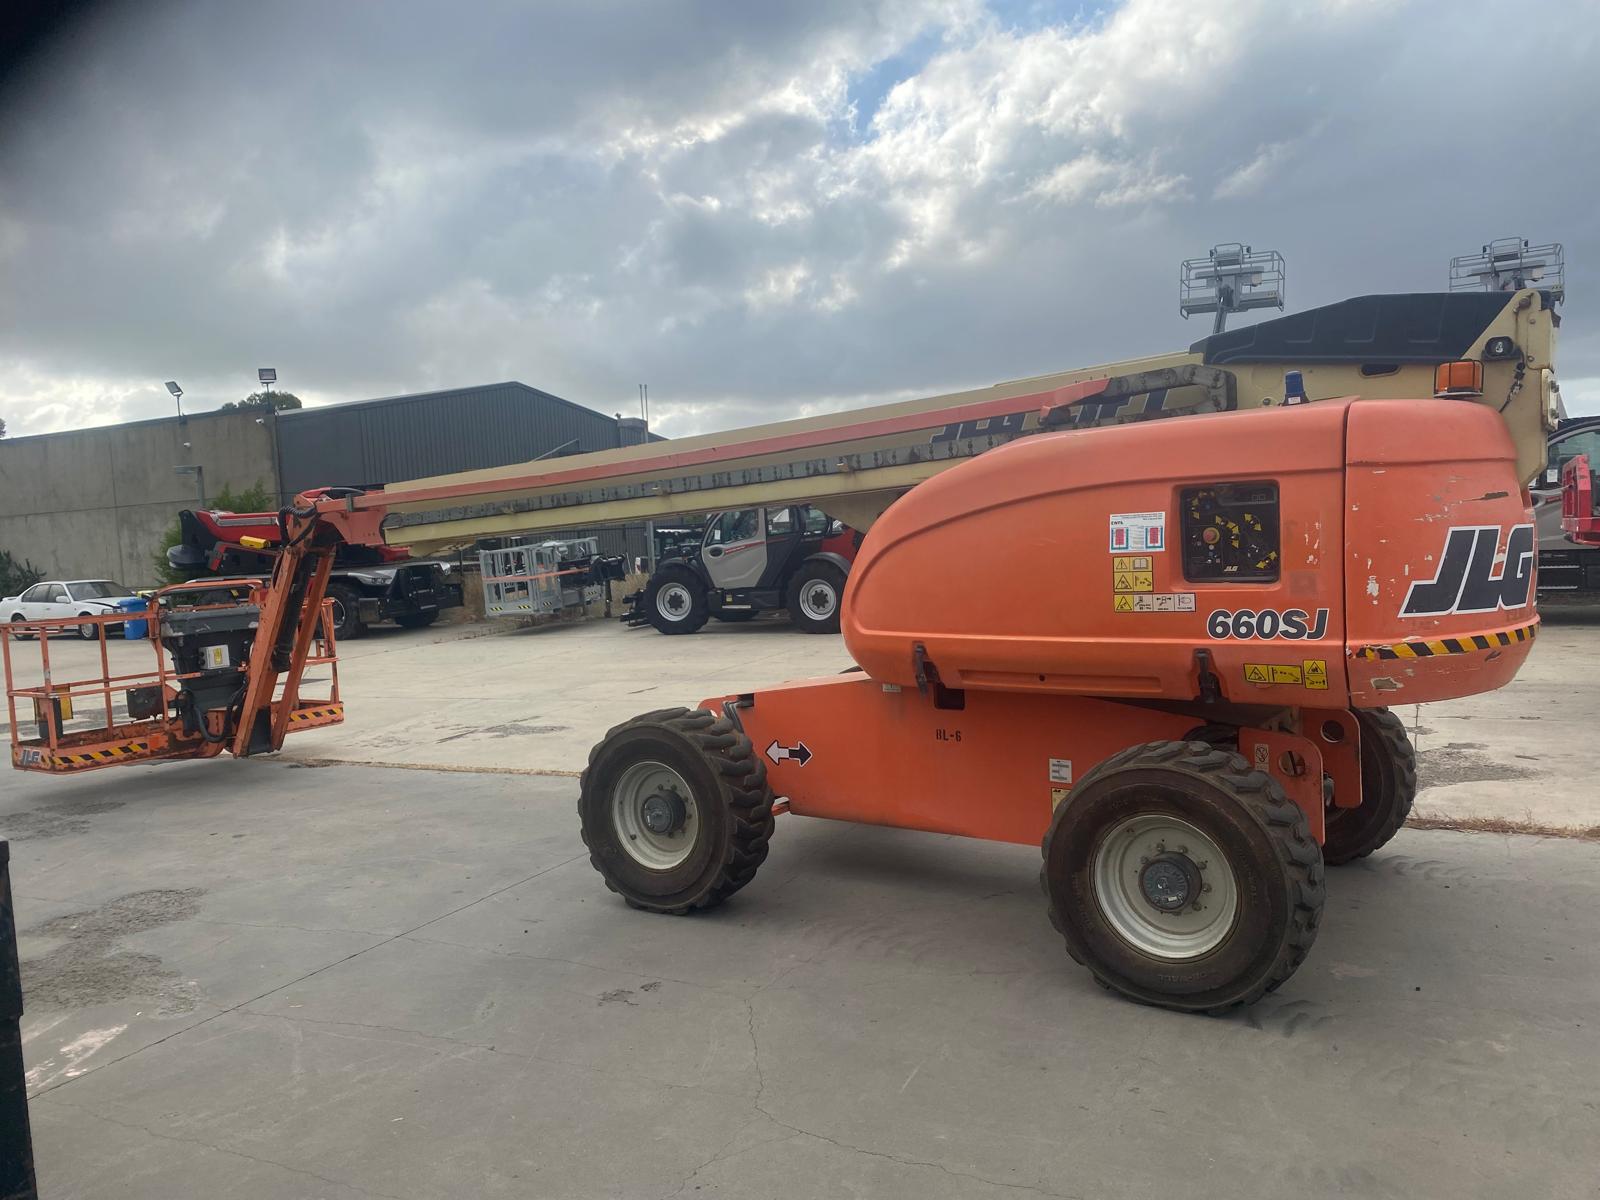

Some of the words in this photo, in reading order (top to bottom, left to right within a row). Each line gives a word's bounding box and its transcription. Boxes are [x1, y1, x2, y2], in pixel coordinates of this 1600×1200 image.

[1398, 524, 1535, 617] JLG
[1207, 608, 1329, 640] 660SJ
[936, 728, 962, 742] BL-6
